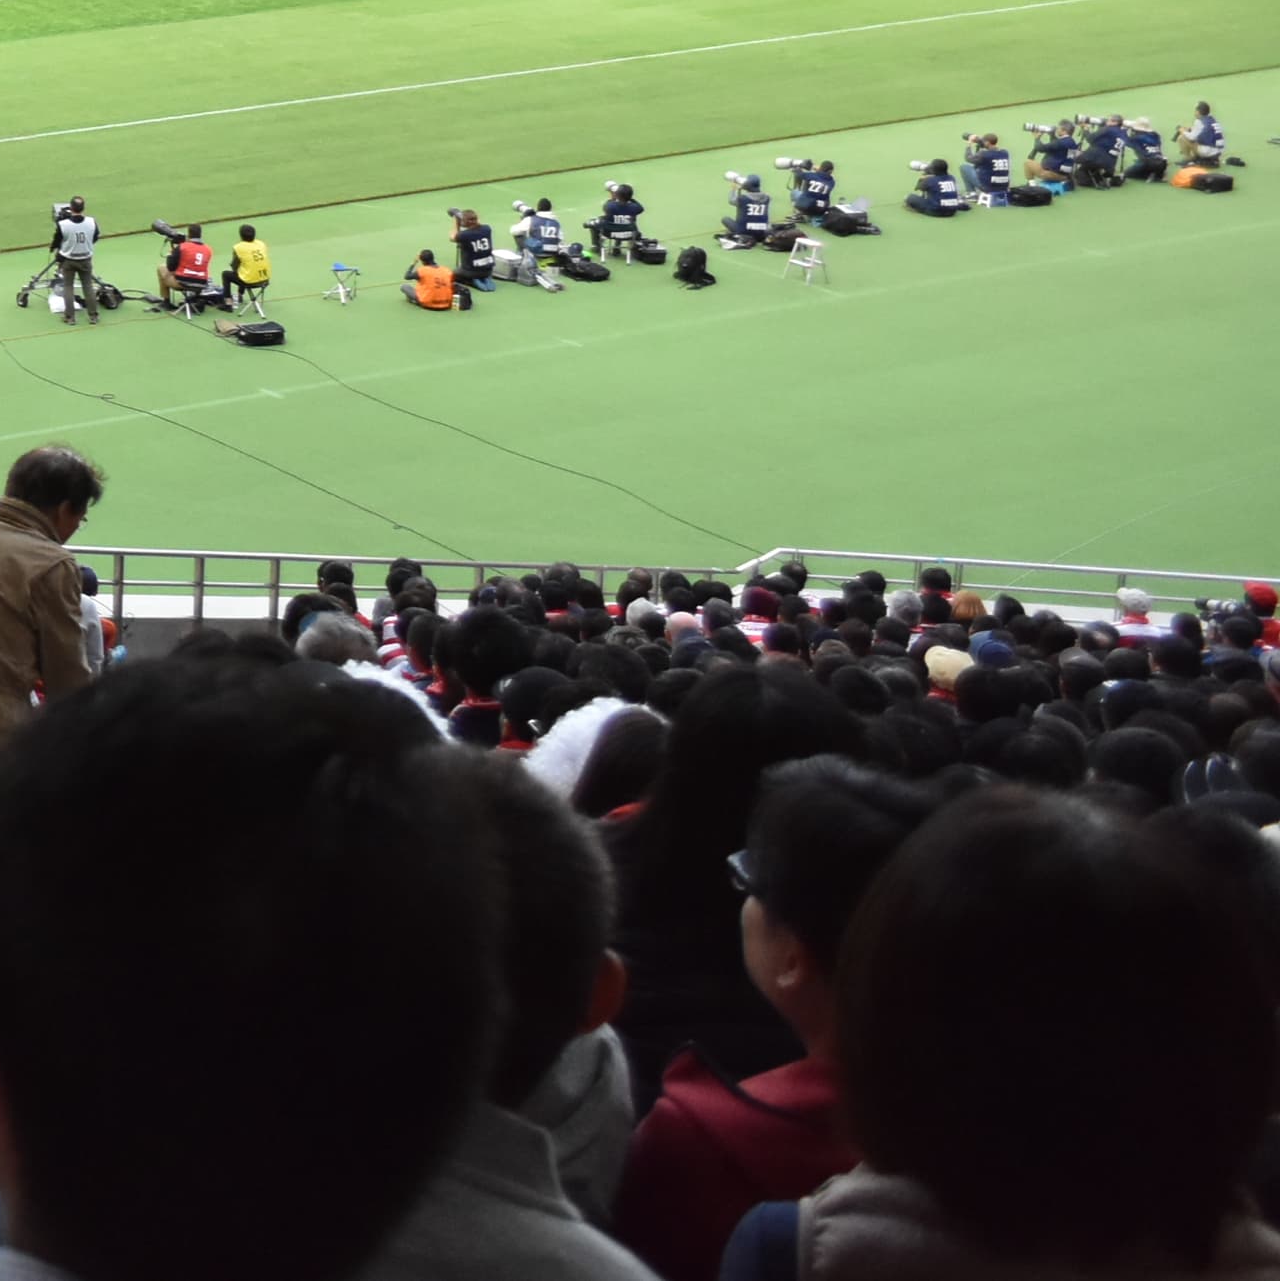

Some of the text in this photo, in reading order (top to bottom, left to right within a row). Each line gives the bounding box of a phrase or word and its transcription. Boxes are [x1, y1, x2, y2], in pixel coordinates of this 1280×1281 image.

[75, 232, 85, 243] 10
[471, 238, 489, 252] 143
[195, 253, 204, 265] 9
